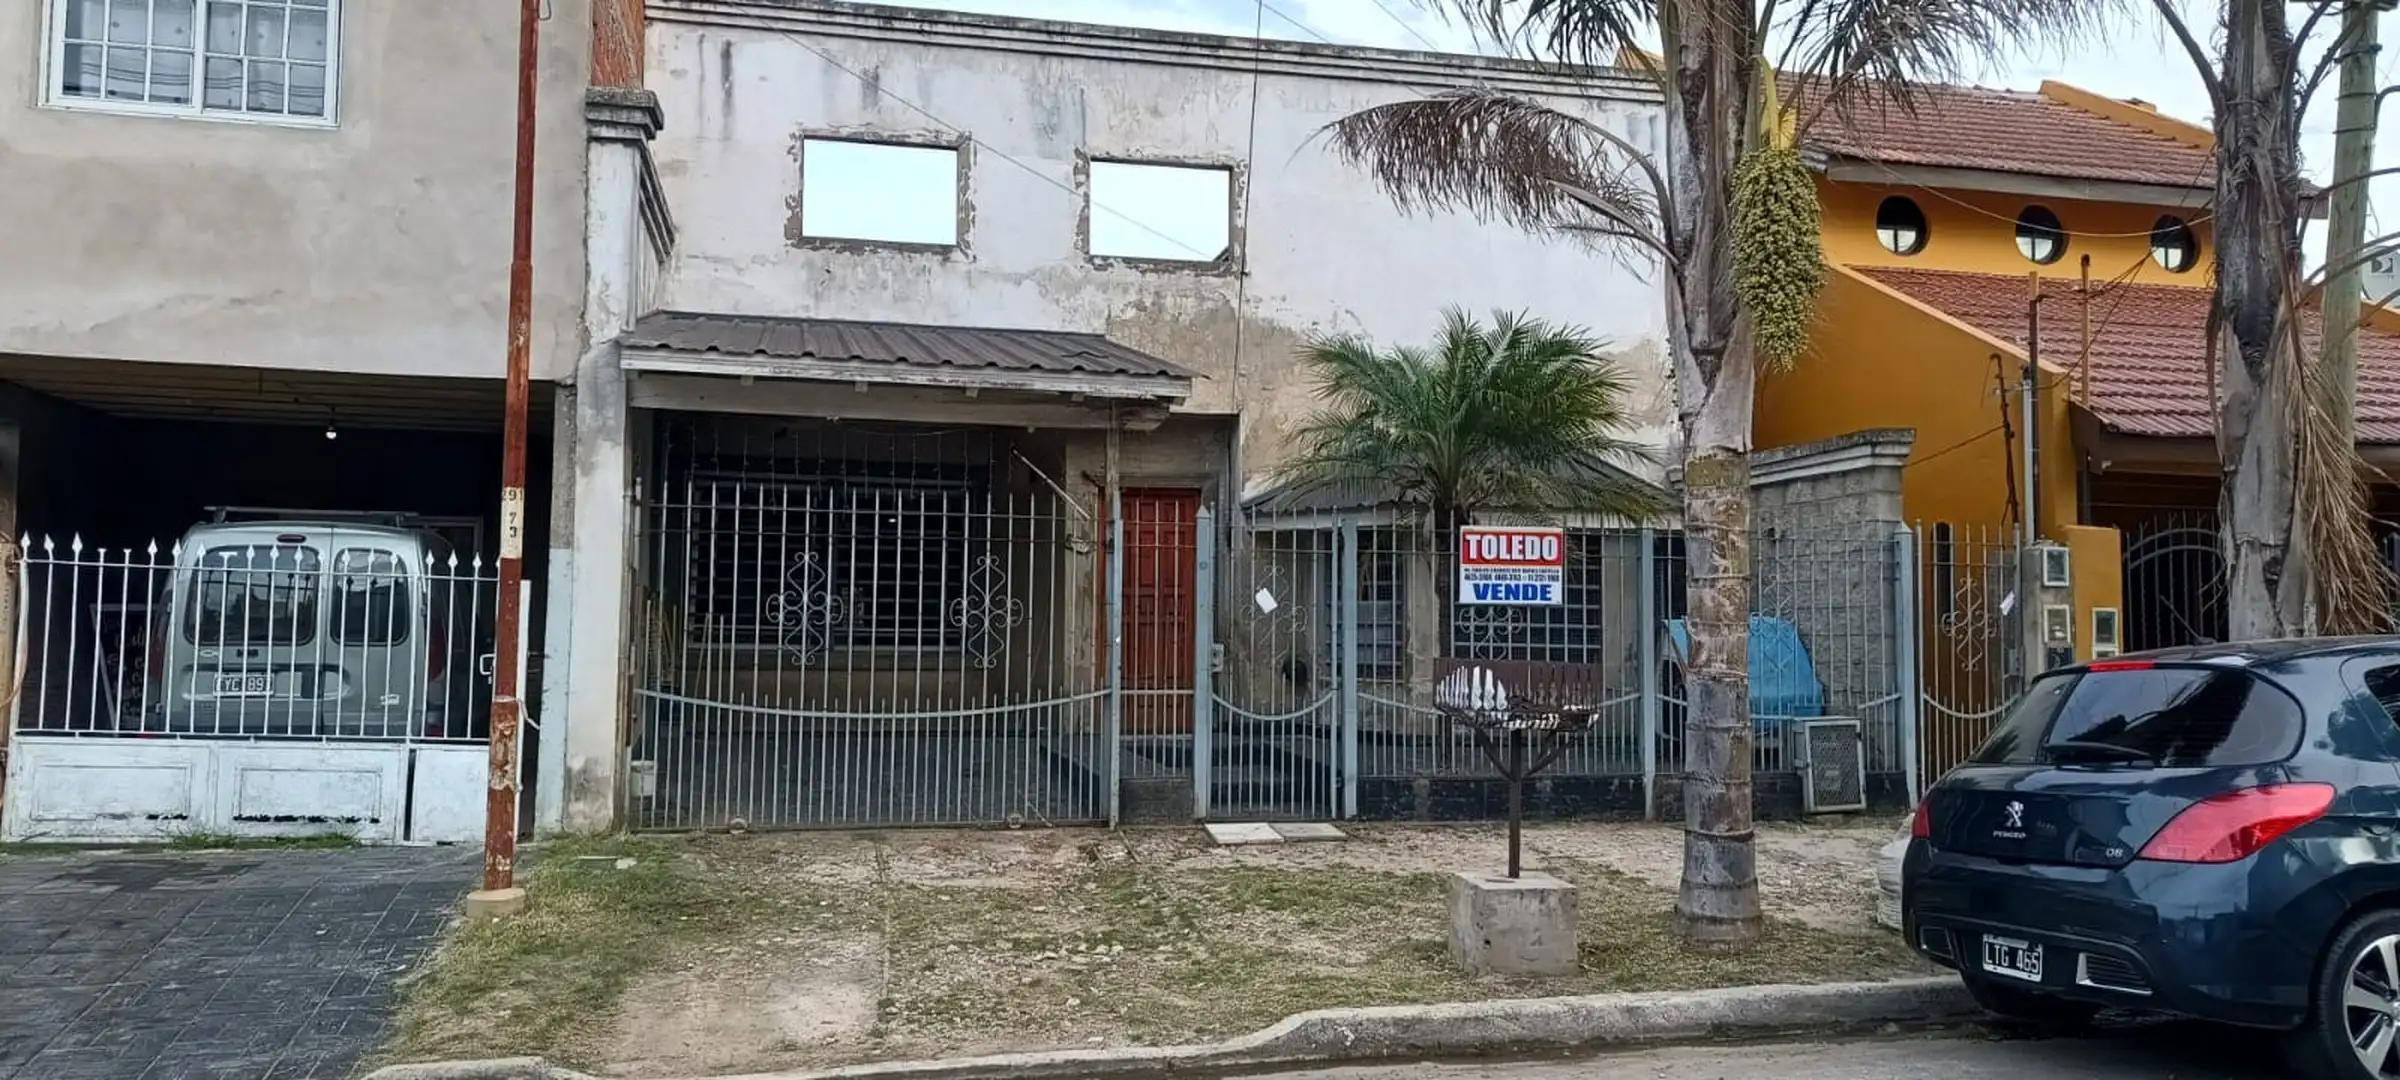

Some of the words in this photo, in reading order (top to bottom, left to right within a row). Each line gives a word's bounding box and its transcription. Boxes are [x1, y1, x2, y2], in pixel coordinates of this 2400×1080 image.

[1464, 533, 1559, 561] TOLEDO
[1472, 582, 1553, 602] VENDE
[247, 677, 271, 691] 89
[1985, 942, 2009, 967] LTG
[2015, 949, 2040, 974] 465
